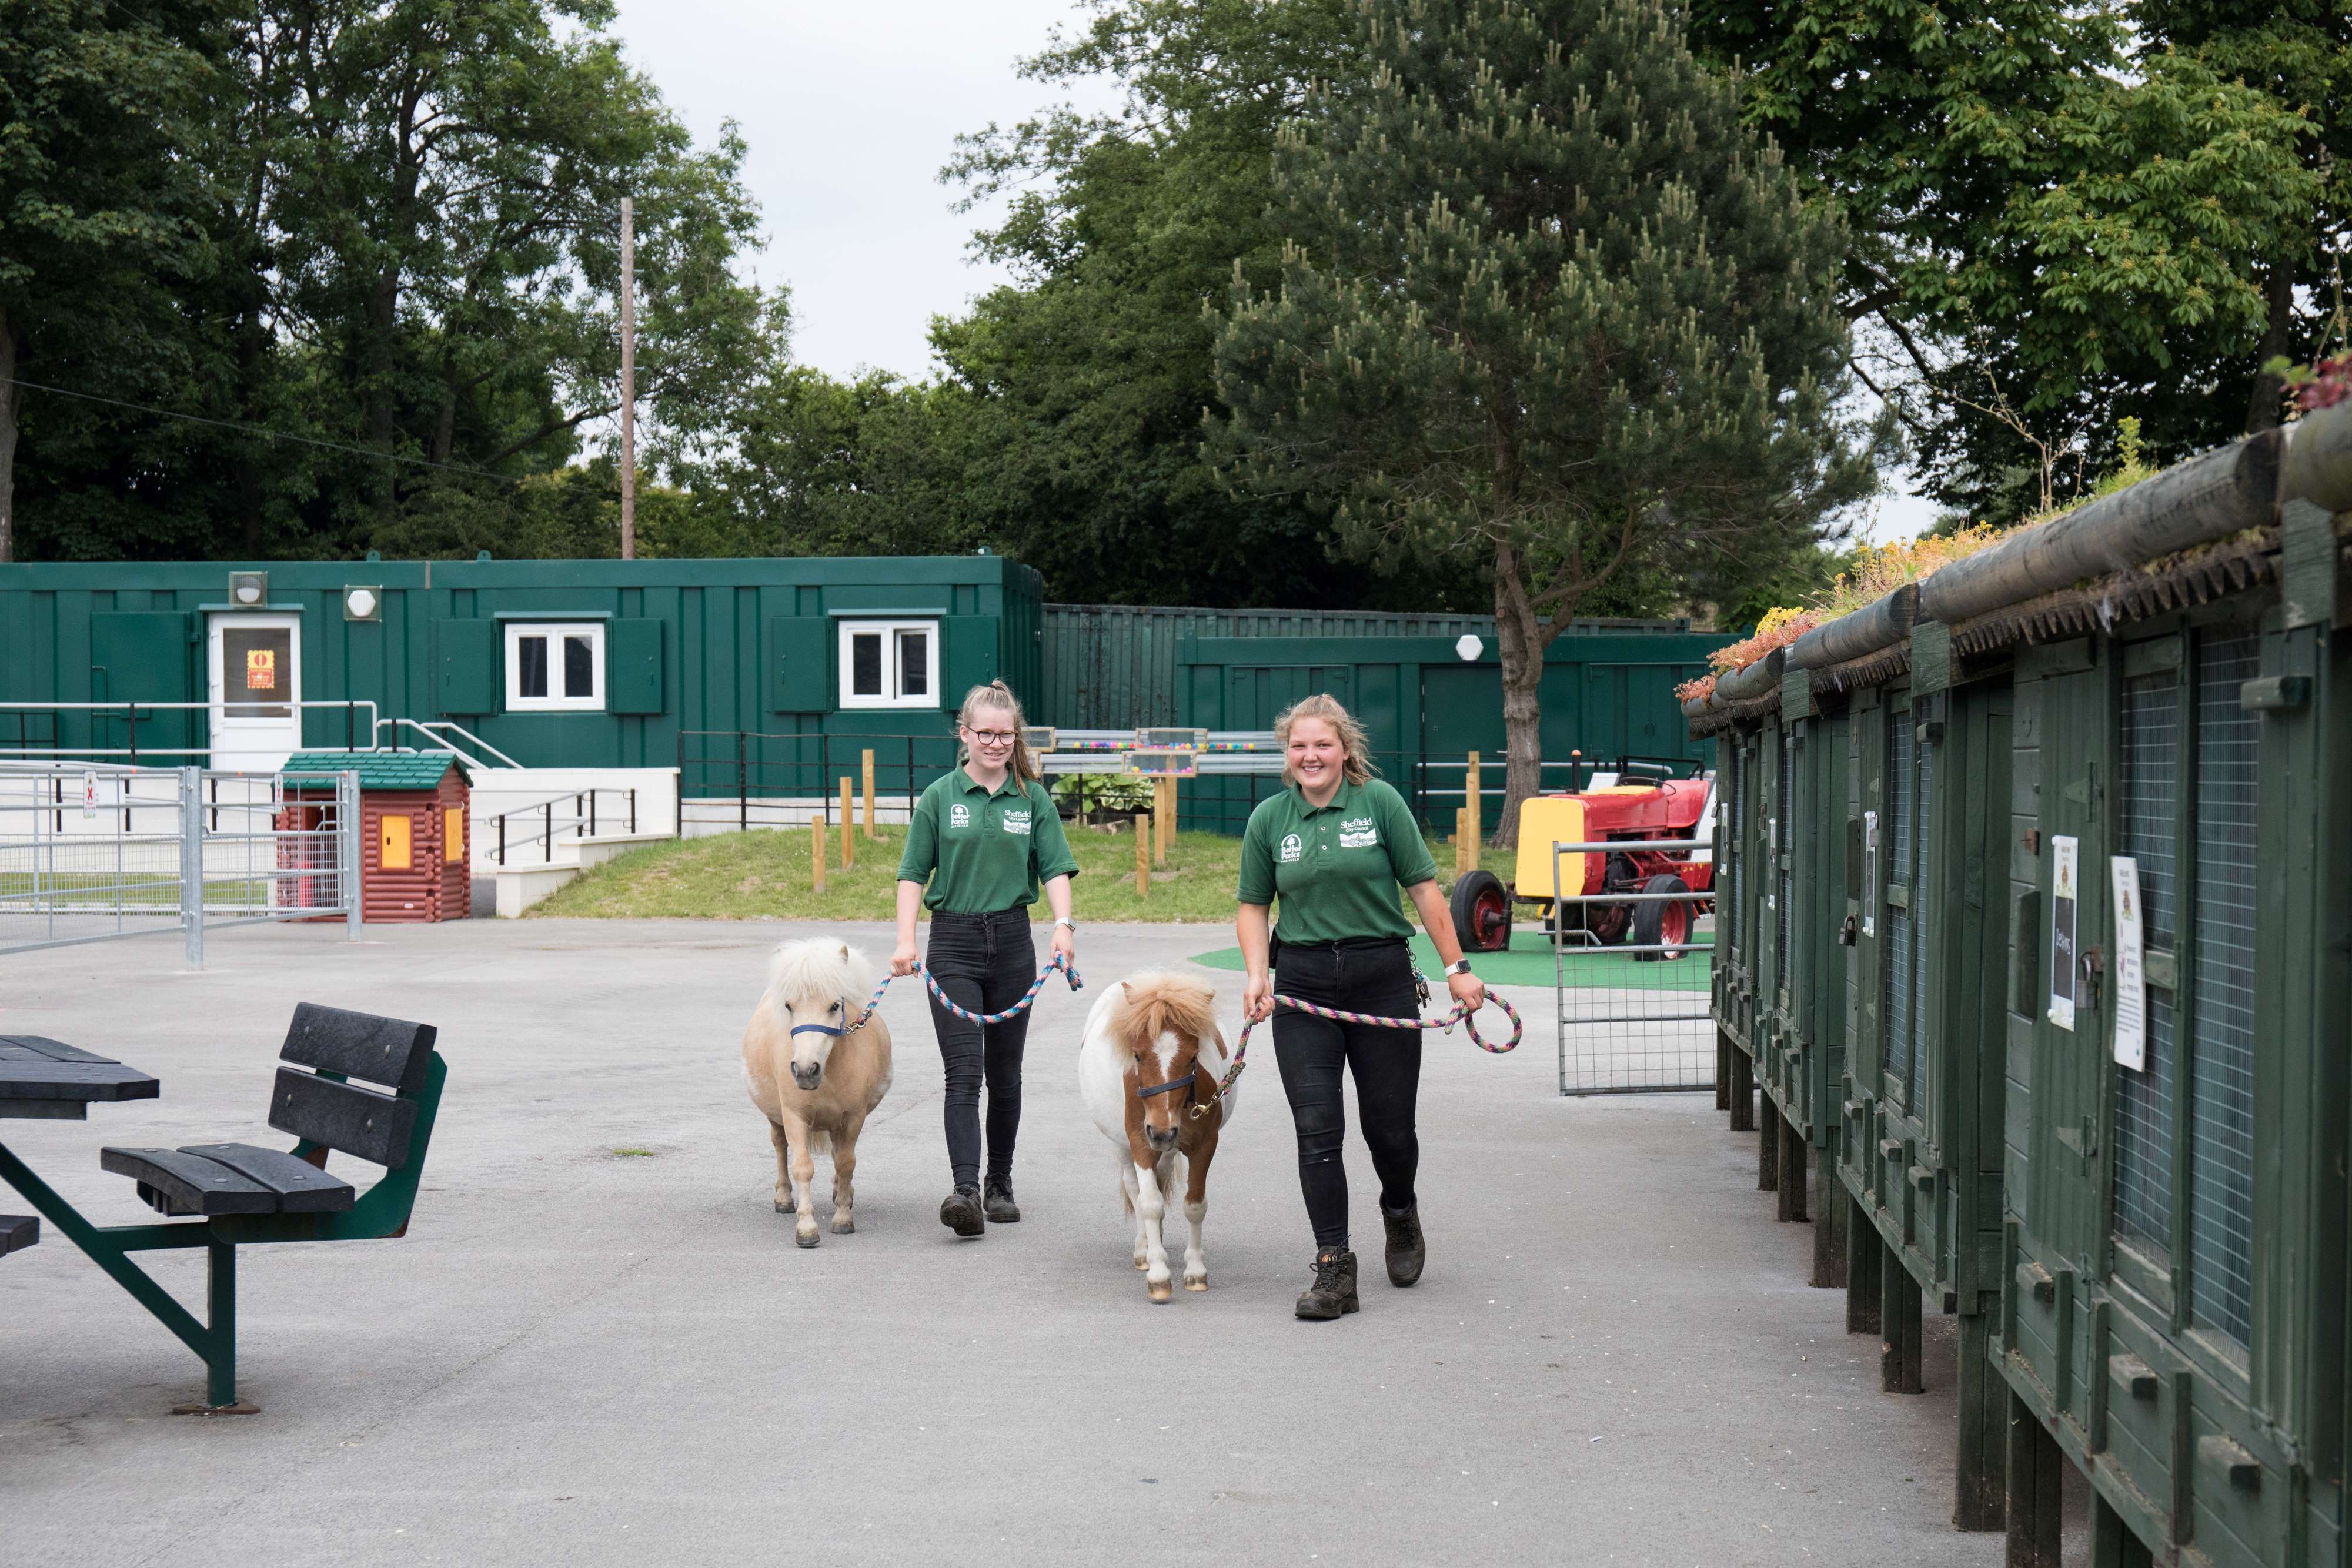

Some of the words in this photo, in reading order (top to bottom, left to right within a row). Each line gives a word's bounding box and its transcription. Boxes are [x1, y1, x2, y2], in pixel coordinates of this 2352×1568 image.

[1005, 809, 1031, 818] Sheffield
[1341, 817, 1372, 829] Sheffield
[1281, 852, 1300, 860] Parks
